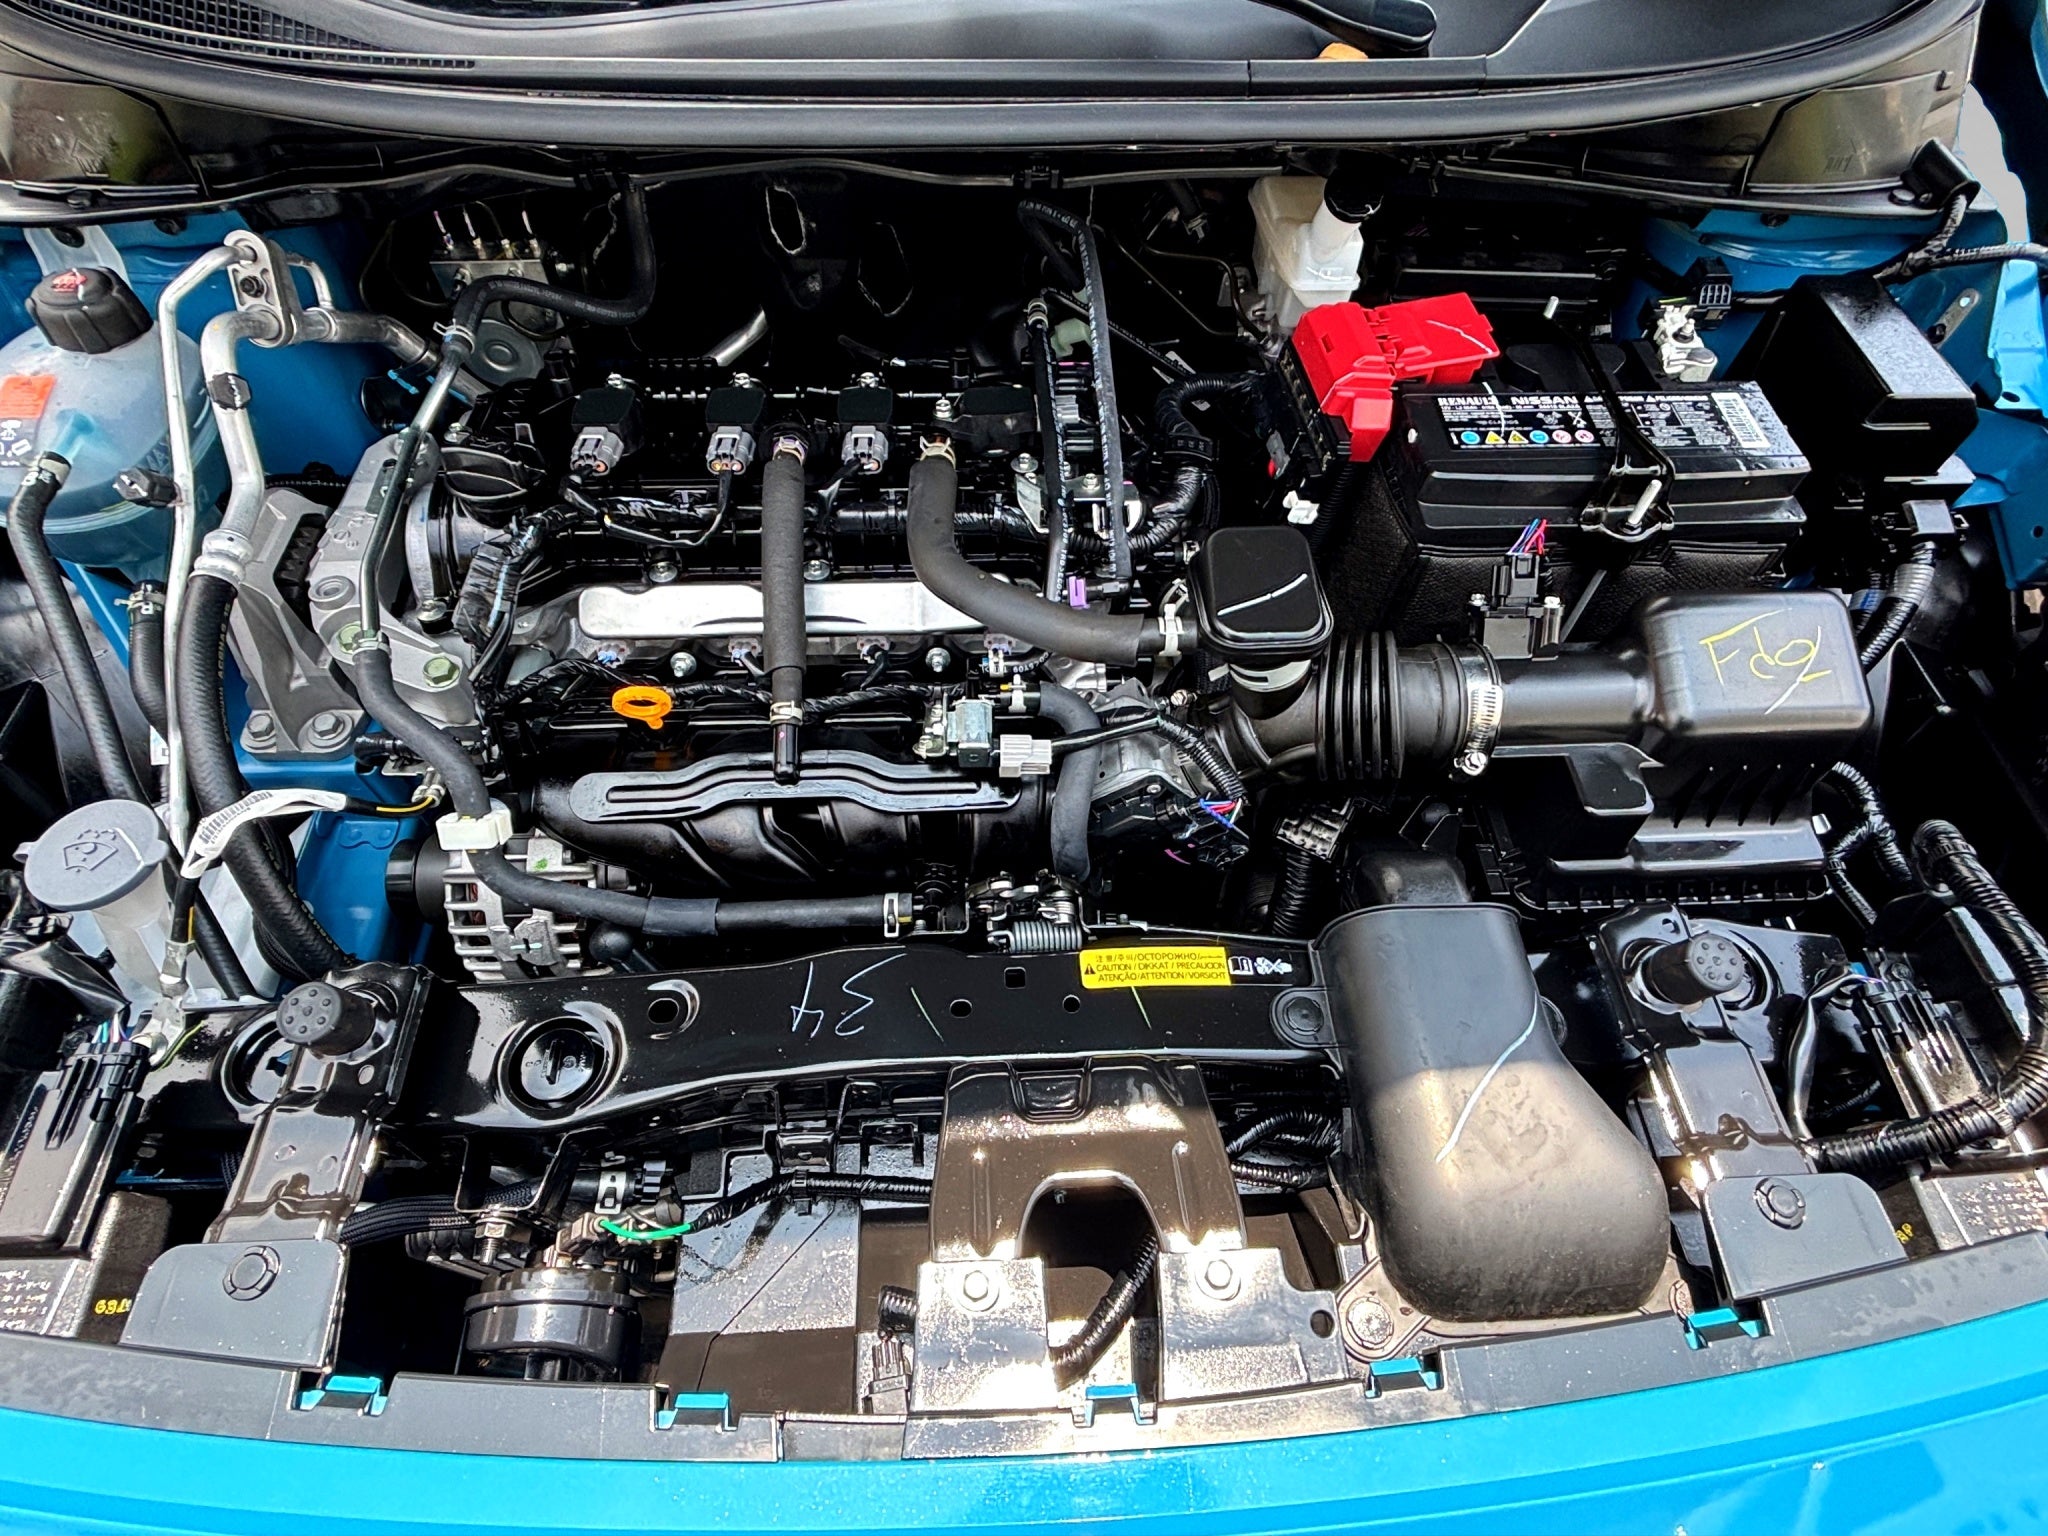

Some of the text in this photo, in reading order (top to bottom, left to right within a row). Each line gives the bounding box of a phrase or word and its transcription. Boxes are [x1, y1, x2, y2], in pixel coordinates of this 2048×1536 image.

[1510, 395, 1579, 405] NISSAN
[1096, 963, 1131, 972] CAUTION
[1138, 962, 1169, 970] DIKKAT
